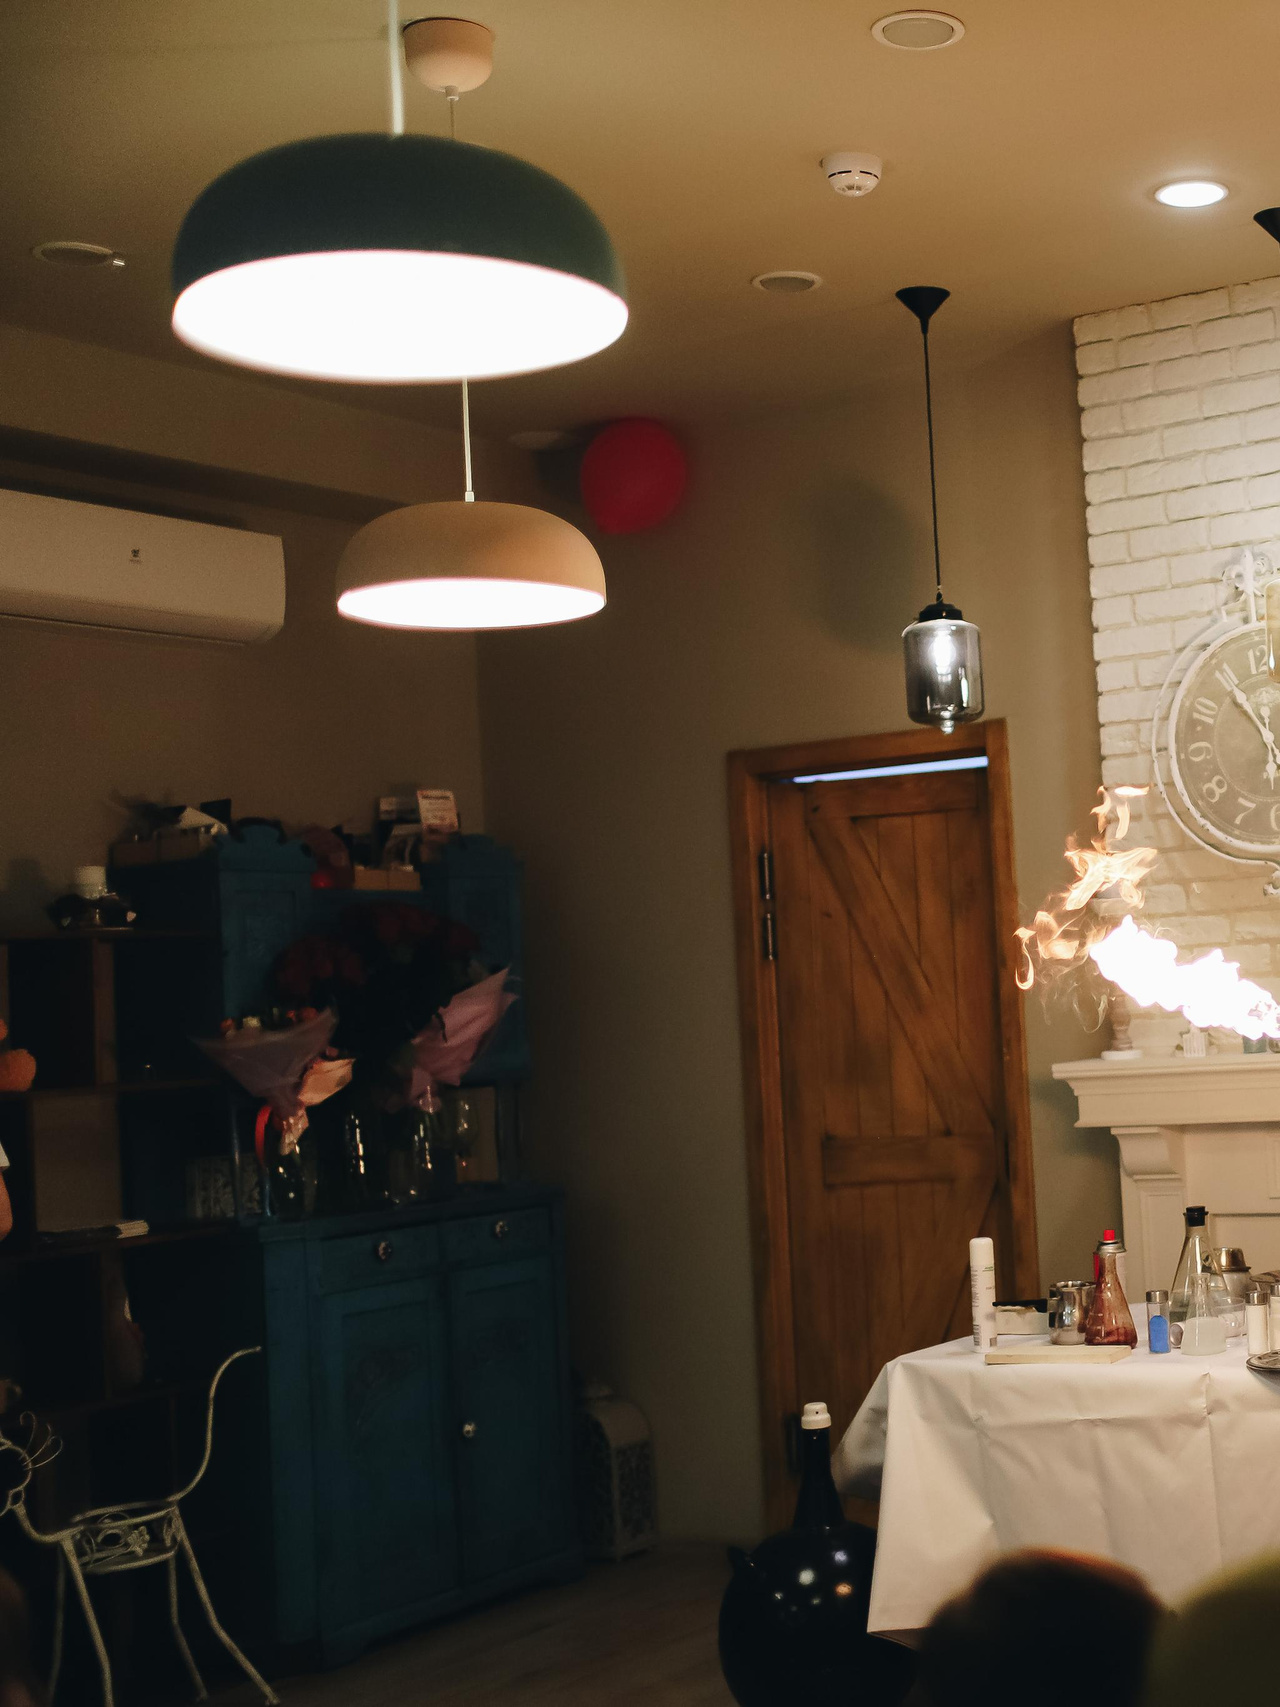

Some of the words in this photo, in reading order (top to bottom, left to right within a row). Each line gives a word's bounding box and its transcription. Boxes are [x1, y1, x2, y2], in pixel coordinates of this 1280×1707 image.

[1214, 662, 1239, 691] 11
[1192, 697, 1218, 725] 10
[1189, 741, 1213, 761] 9
[1202, 775, 1228, 803] 8
[1234, 797, 1256, 824] 7
